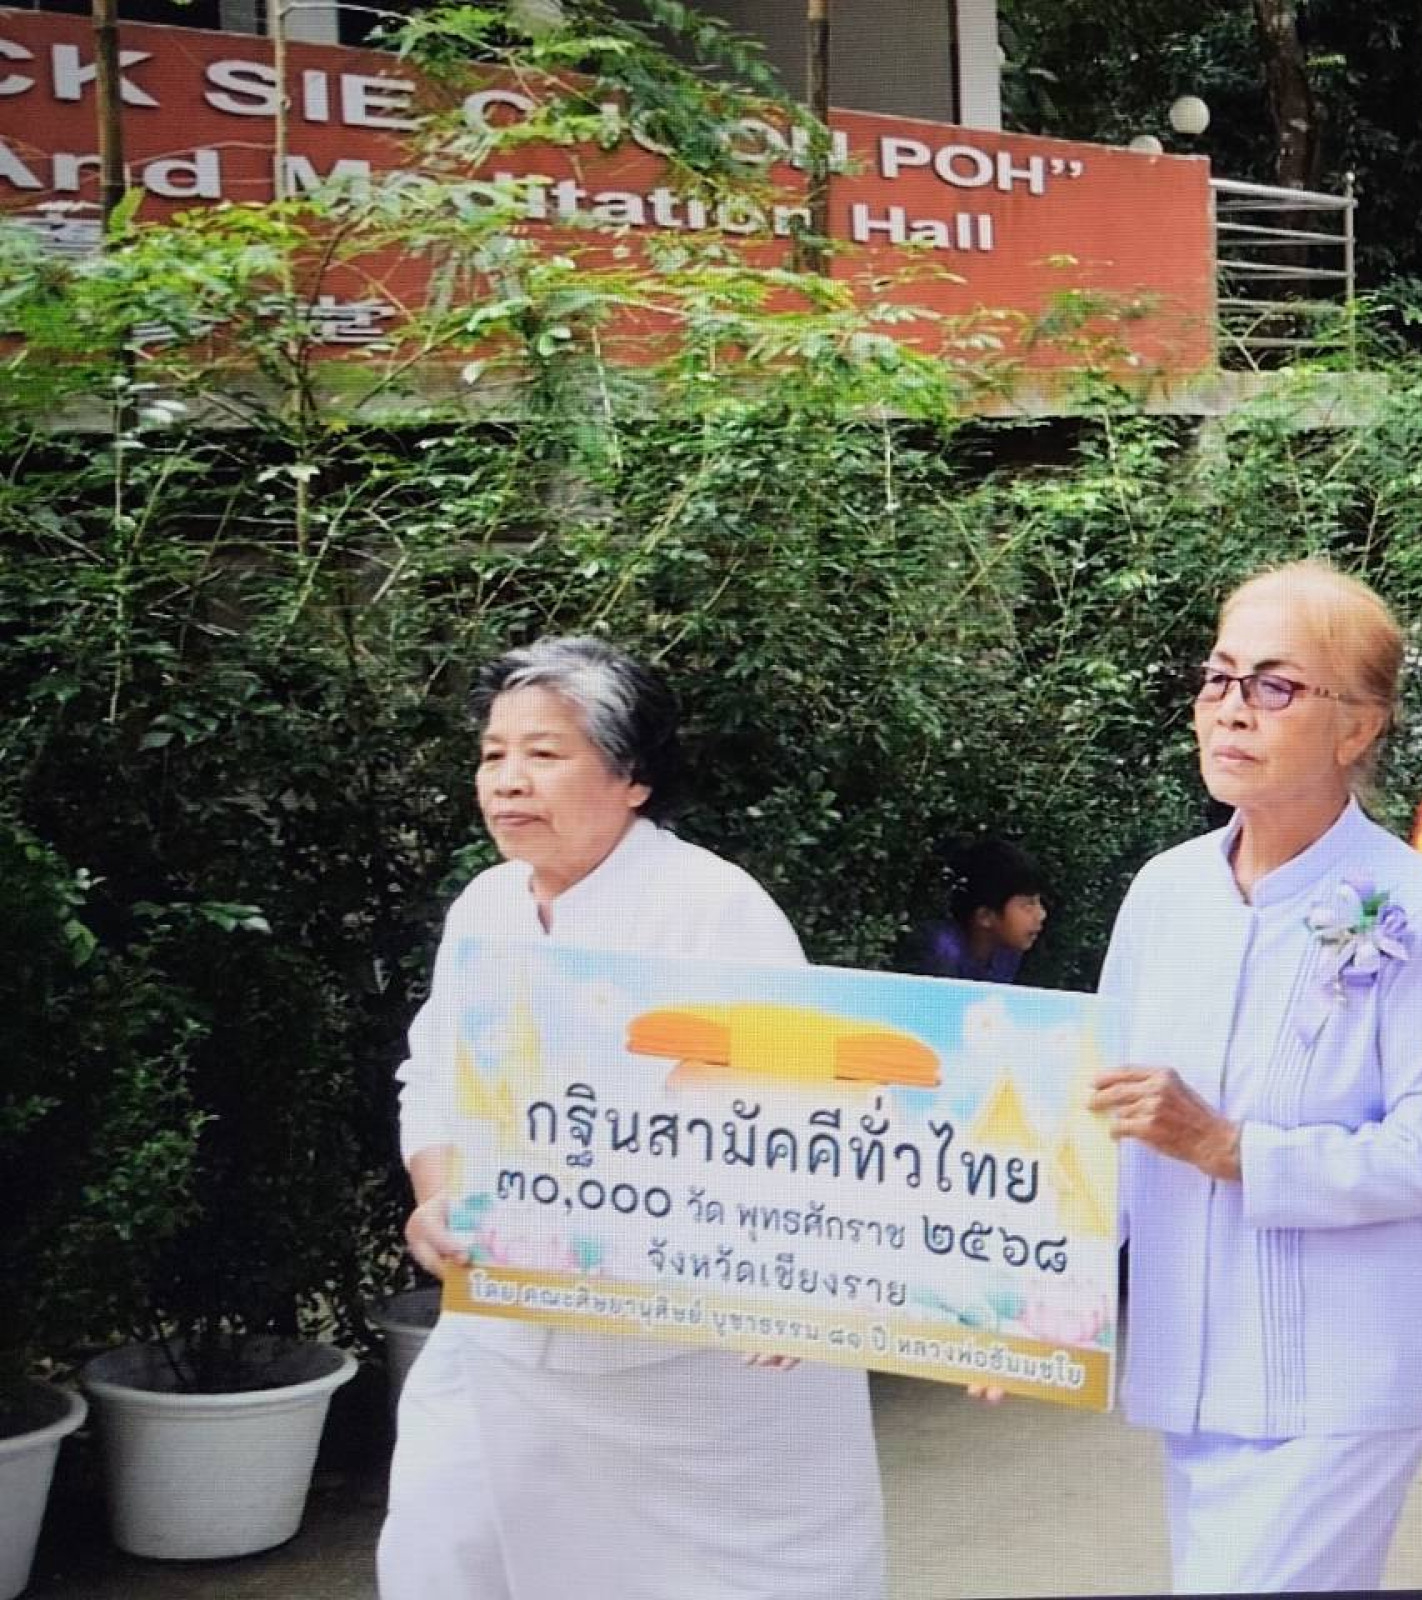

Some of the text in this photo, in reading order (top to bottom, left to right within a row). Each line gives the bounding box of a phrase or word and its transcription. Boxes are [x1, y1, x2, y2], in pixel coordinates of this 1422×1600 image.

[204, 60, 420, 130] SIE
[852, 203, 993, 250] Hall
[527, 1083, 1039, 1202] กฐินสามัคคีทั่วไทย
[497, 1169, 1068, 1273] ๓๐,๐๐๐ วัด พุทธศักราช ๒๕๖๘
[648, 1238, 907, 1306] จังหวัดเชียงราย
